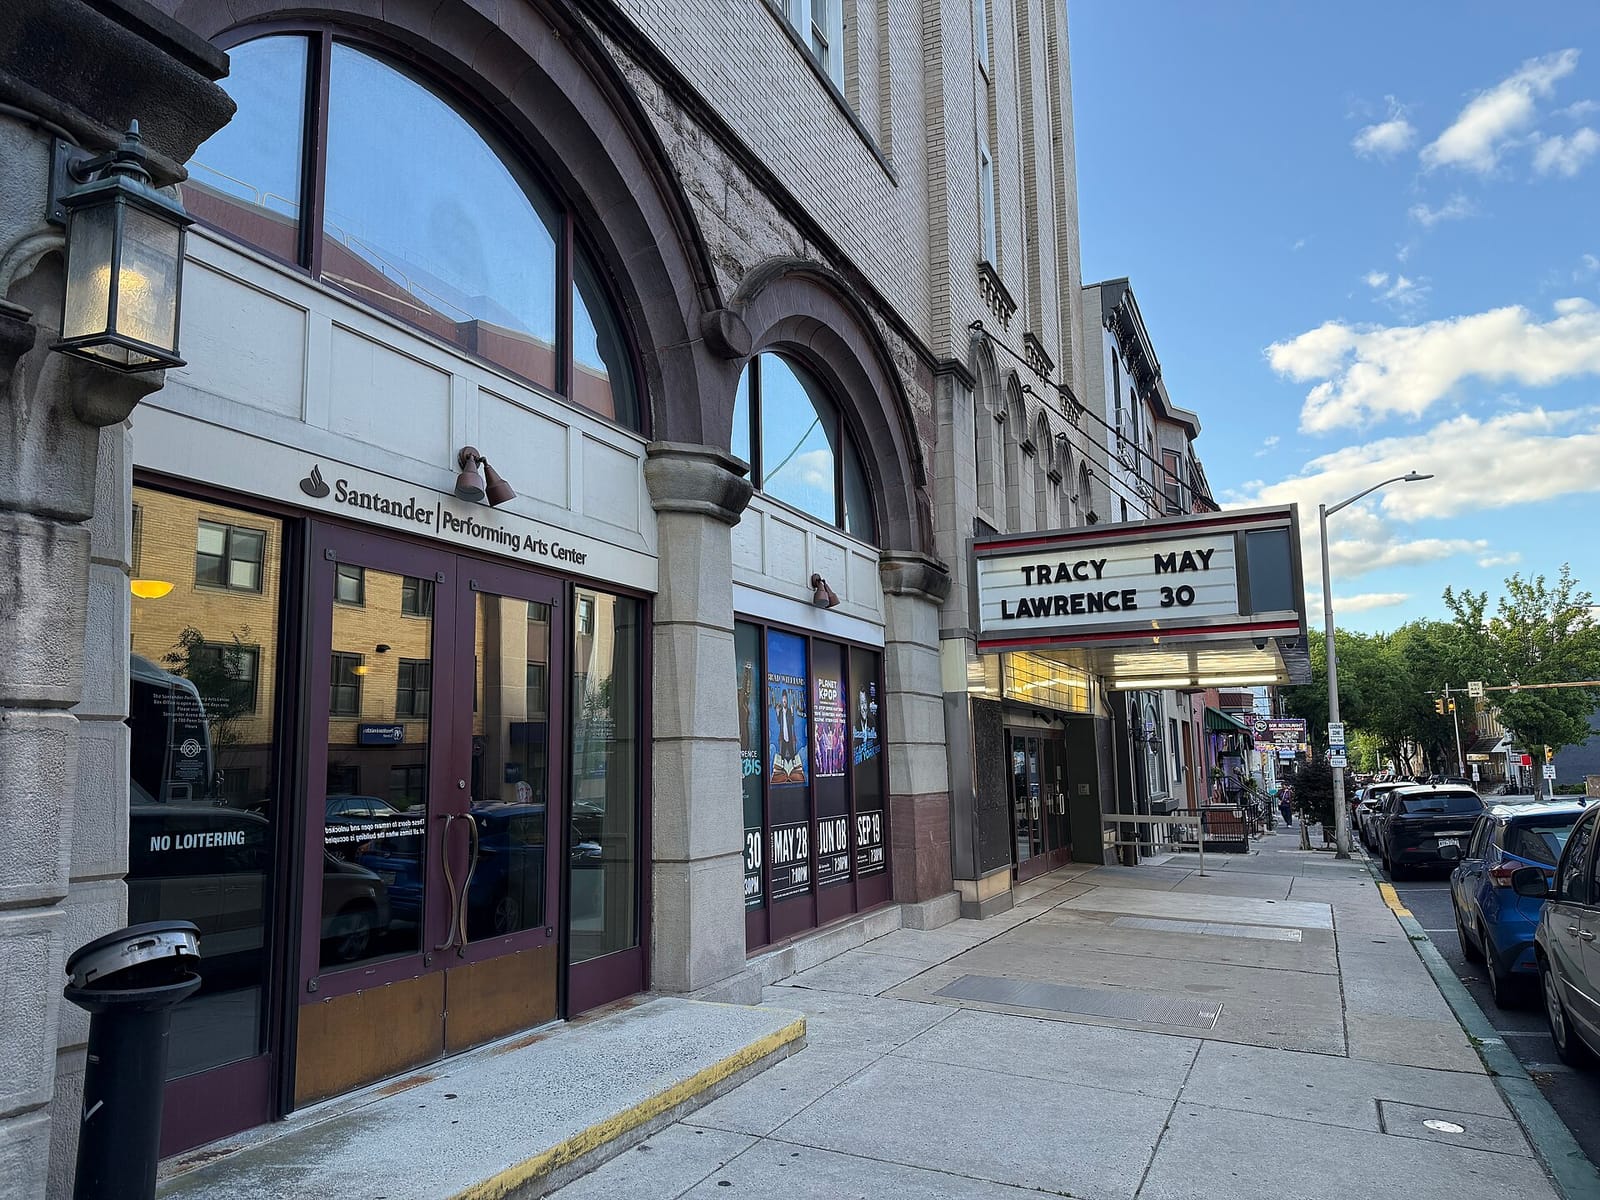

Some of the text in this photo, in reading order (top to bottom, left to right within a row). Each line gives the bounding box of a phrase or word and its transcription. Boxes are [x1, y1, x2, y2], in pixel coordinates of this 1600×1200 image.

[335, 479, 434, 525] Santander
[443, 511, 587, 566] Performing Arts Center
[1021, 548, 1215, 586] TRACY MAY
[1001, 584, 1196, 620] LAWRENCE 30
[818, 678, 837, 689] PLANET
[818, 688, 838, 700] KPOP
[740, 750, 757, 758] RENCE
[150, 830, 245, 852] NO LOITERING
[774, 828, 795, 864] MAY
[796, 827, 808, 859] 28
[819, 819, 847, 854] JUN 08
[857, 813, 880, 846] SEP 19
[747, 832, 761, 870] 30
[744, 876, 759, 895] 30PM
